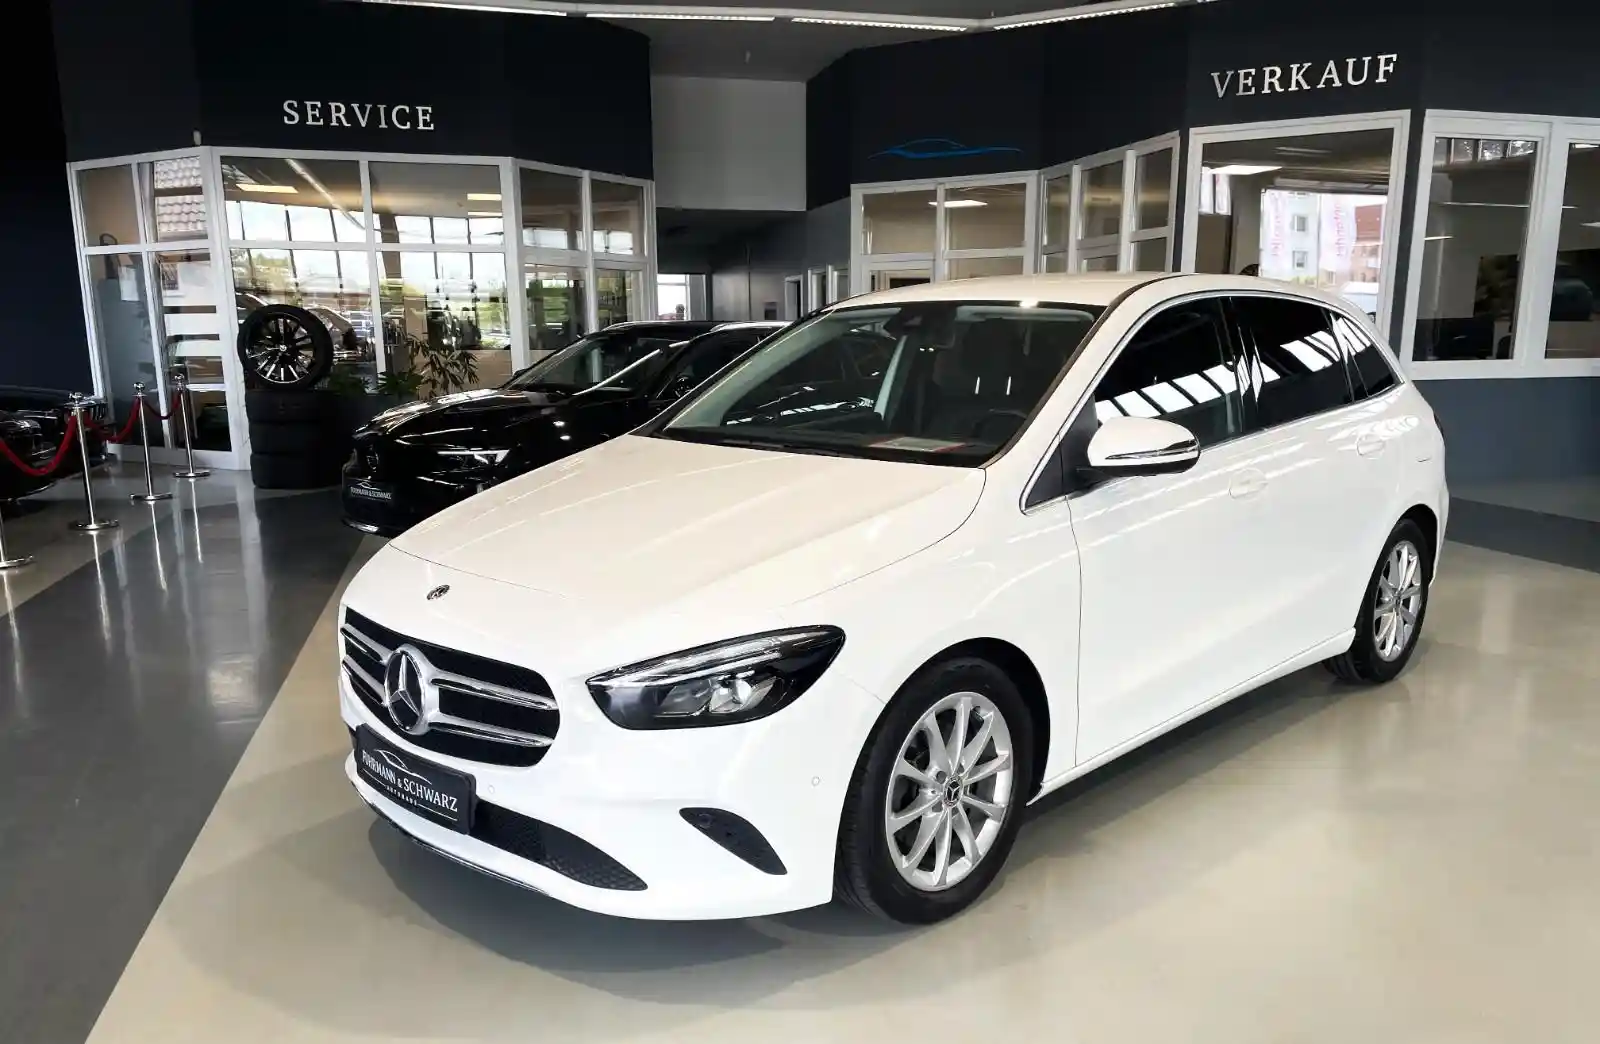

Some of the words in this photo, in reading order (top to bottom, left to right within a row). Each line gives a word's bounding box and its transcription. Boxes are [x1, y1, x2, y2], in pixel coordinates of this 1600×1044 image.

[1210, 53, 1398, 98] VERKAUF
[282, 99, 435, 131] SERVICE
[361, 750, 396, 784] FUHRMANN
[397, 778, 402, 788] &
[403, 777, 458, 812] SCHWARZ
